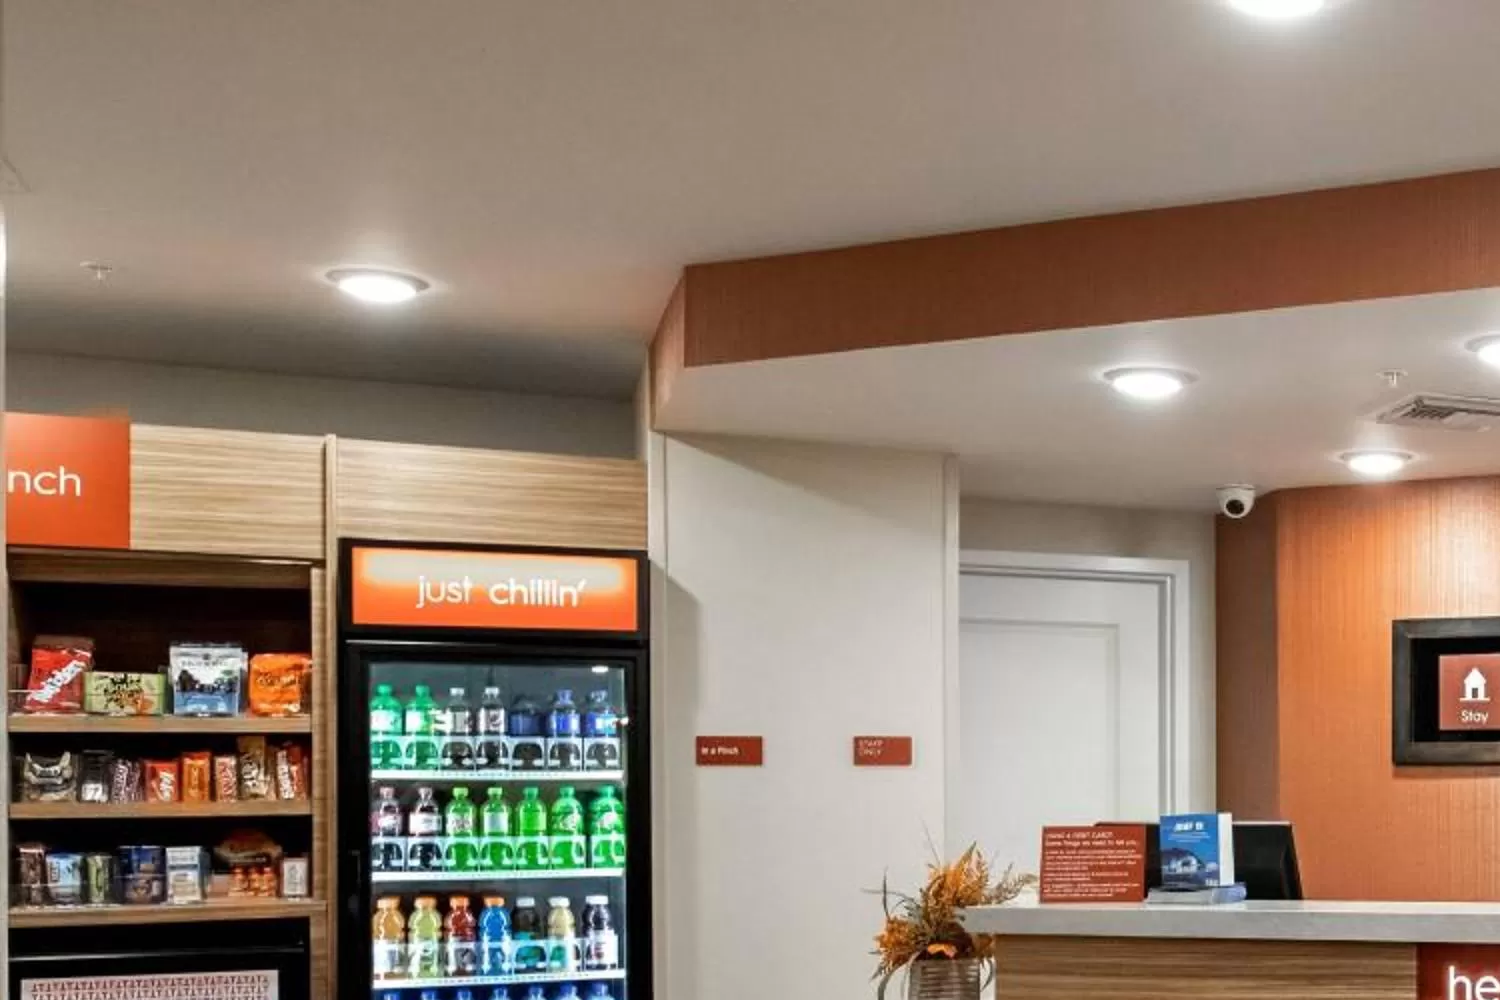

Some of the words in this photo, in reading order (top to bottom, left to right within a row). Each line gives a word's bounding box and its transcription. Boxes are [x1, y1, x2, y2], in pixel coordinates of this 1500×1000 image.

[7, 465, 81, 496] nch
[416, 575, 472, 608] just
[1460, 709, 1488, 724] Stay
